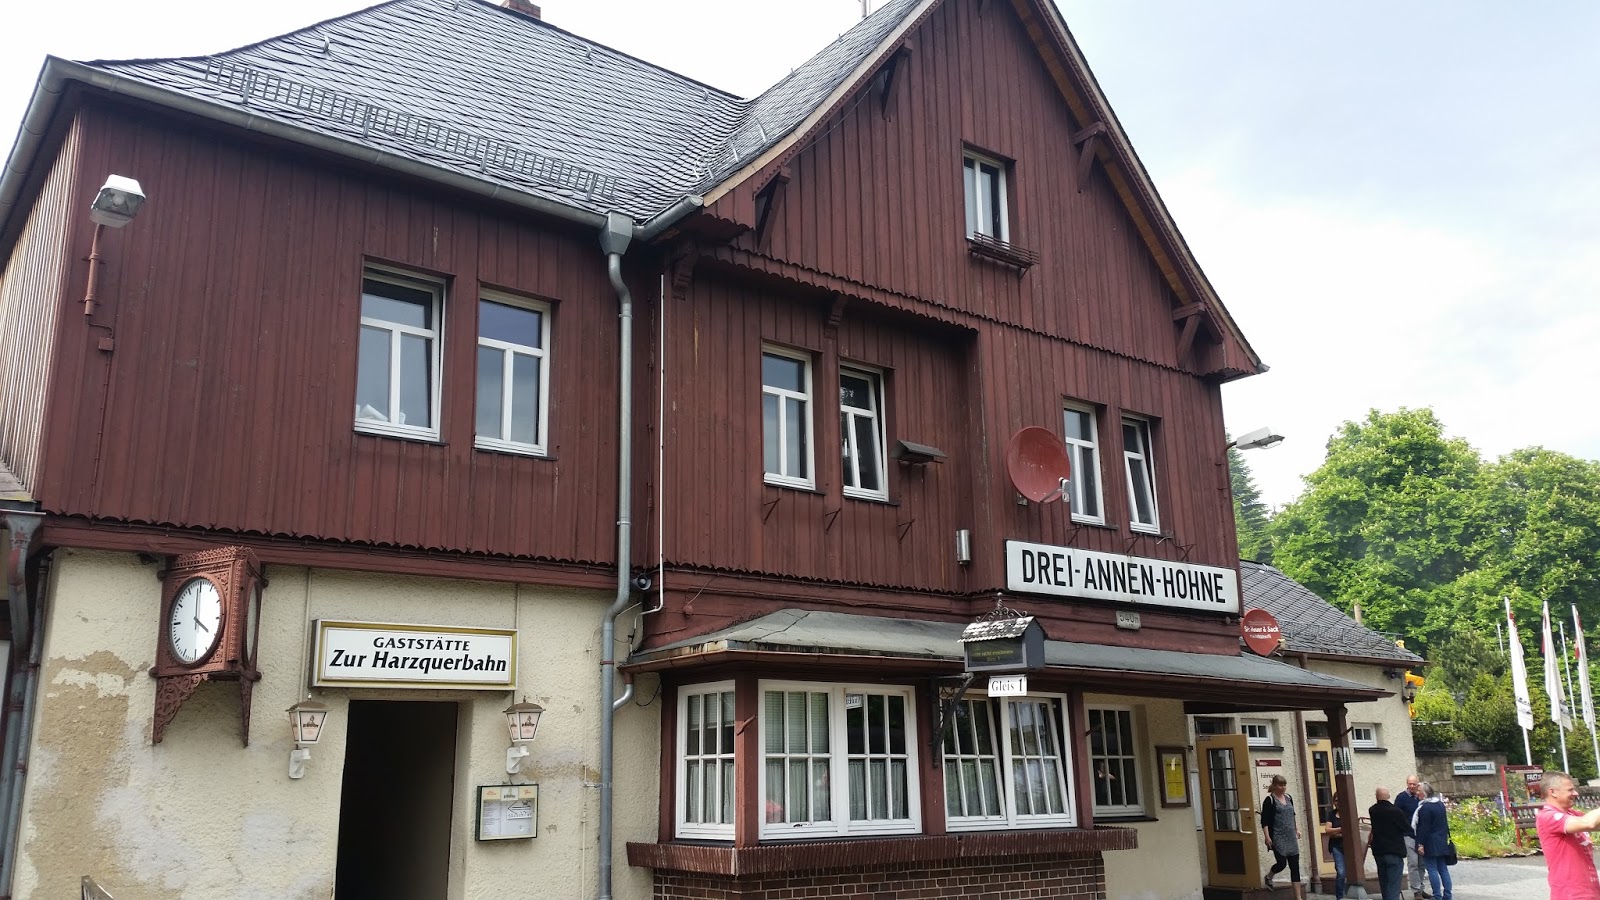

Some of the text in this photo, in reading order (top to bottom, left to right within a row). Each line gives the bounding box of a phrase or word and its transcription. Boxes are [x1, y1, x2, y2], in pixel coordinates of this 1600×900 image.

[1021, 549, 1226, 604] DREI-ANNEN-HOHNE
[373, 637, 470, 651] GASTSTÄTTE
[329, 650, 507, 674] Zur Harzquerbahn
[991, 678, 1023, 692] Gleis 1
